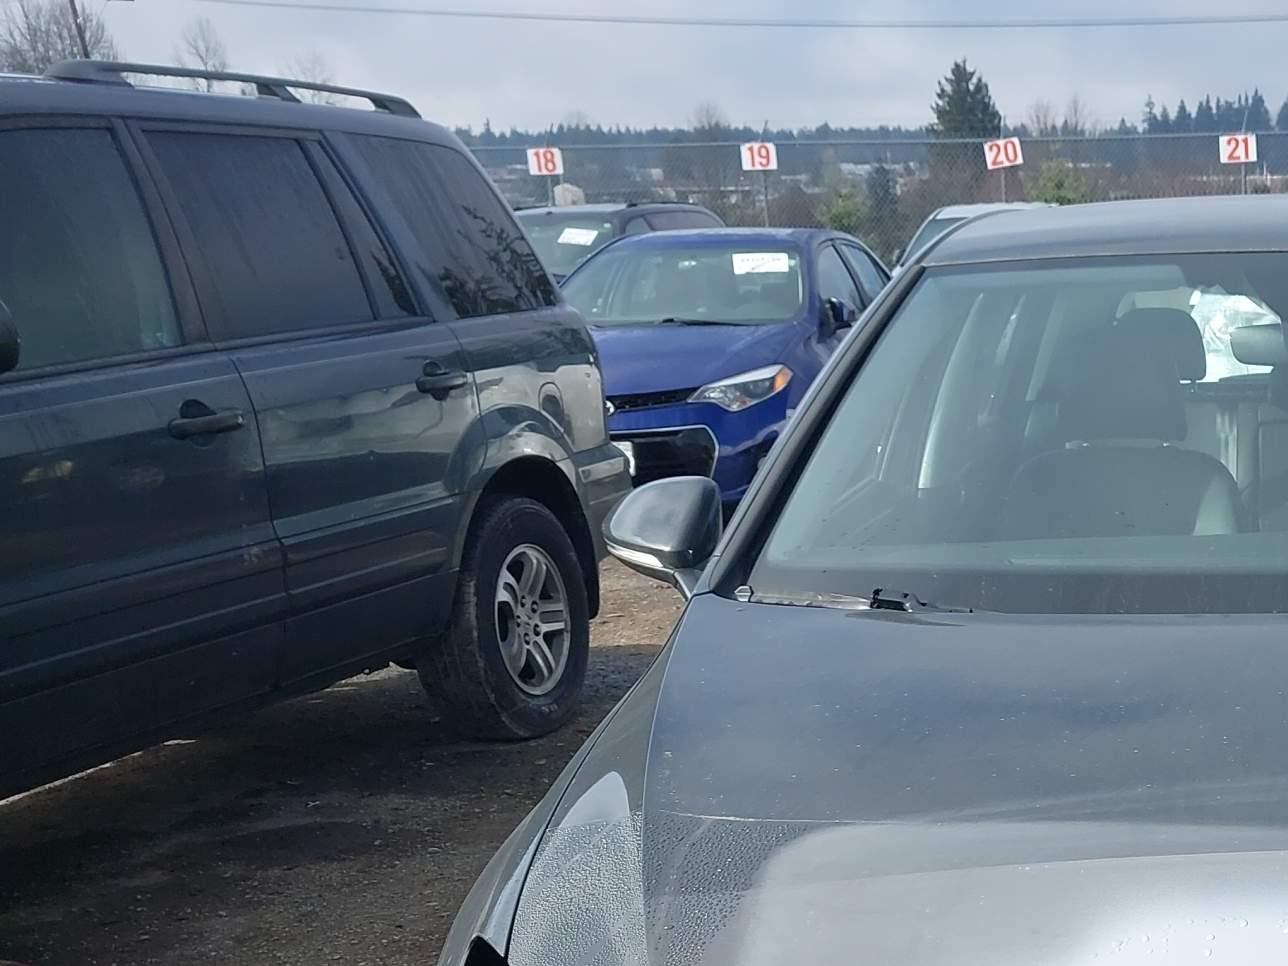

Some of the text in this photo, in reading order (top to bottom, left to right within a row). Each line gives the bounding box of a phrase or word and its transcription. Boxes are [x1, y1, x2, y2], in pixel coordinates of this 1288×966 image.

[747, 144, 770, 168] 19
[989, 140, 1018, 166] 20
[1227, 137, 1249, 160] 21
[533, 150, 556, 172] 18
